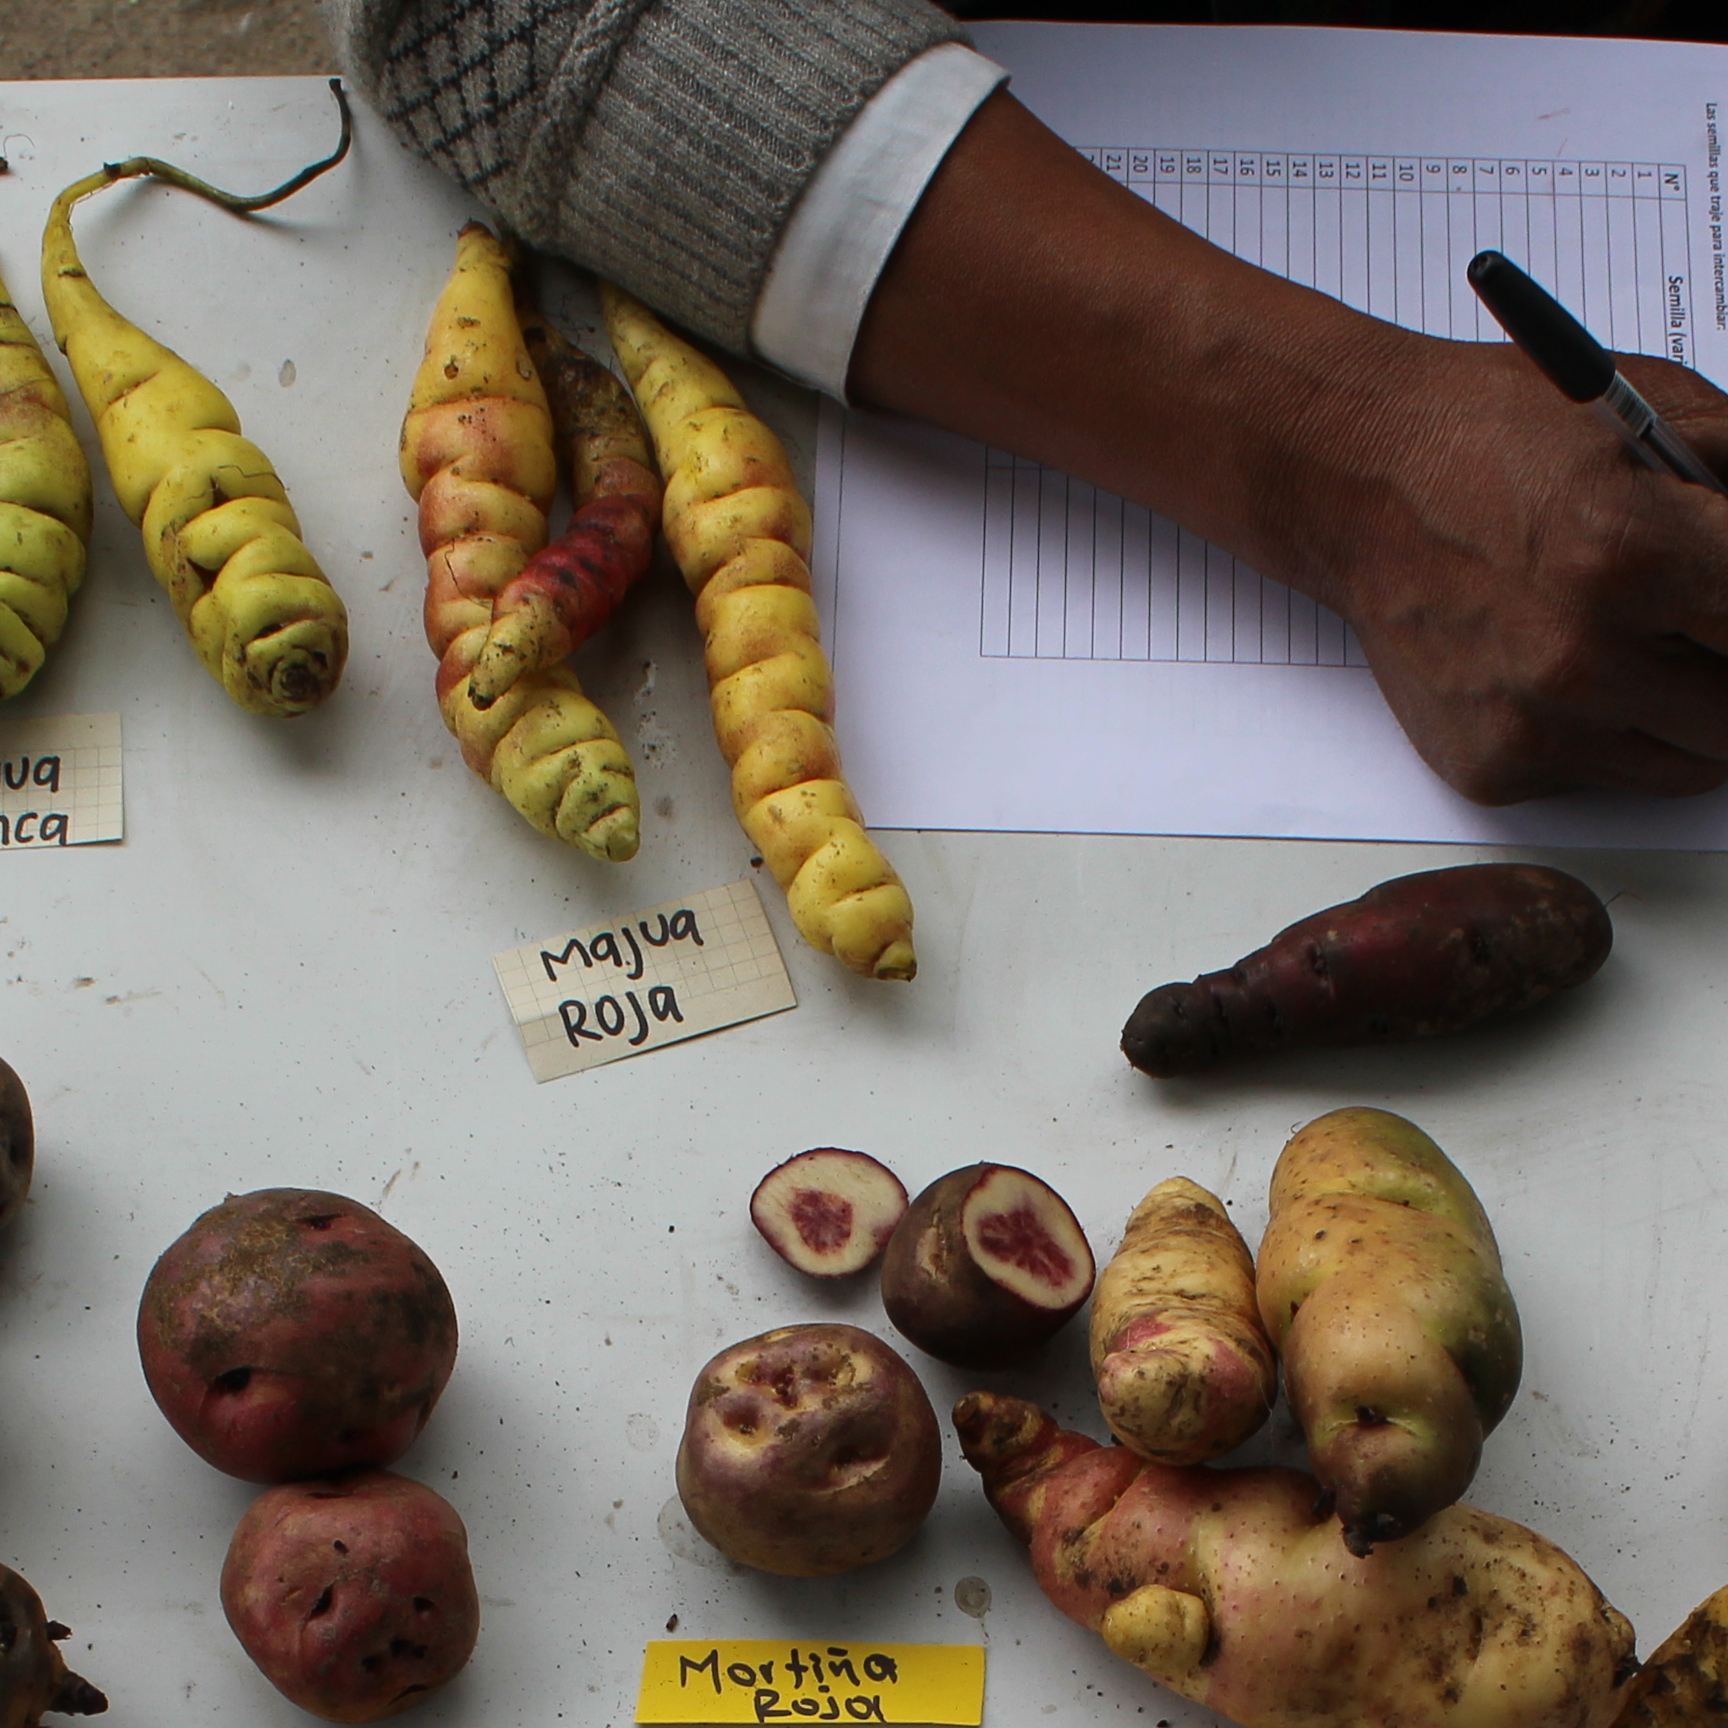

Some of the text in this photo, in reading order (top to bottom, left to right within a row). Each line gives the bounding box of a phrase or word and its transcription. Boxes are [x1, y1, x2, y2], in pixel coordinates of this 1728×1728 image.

[1706, 103, 1718, 120] Las
[1706, 122, 1720, 167] semillas
[1107, 155, 1121, 172] 21
[1134, 156, 1148, 172] 20
[1160, 157, 1174, 173] 19
[1187, 158, 1201, 174] 18
[1214, 158, 1227, 175] 17
[1240, 160, 1254, 176] 16
[1266, 160, 1280, 176] 15
[1293, 162, 1307, 178] 14
[1319, 162, 1333, 178] 13
[1346, 163, 1360, 178] 12
[1372, 163, 1387, 179] 11
[1427, 165, 1441, 173] 9
[1479, 166, 1492, 174] 7
[1506, 167, 1519, 175] 6
[1533, 167, 1546, 175] 5
[1559, 167, 1573, 176] 4
[1399, 165, 1413, 181] 10
[1585, 168, 1599, 177] 3
[1612, 169, 1625, 178] 2
[1638, 170, 1652, 178] 1
[1704, 170, 1720, 192] que
[1706, 194, 1724, 221] traje
[1708, 224, 1724, 251] para
[1668, 276, 1683, 327] Semilla
[539, 908, 704, 983] Majua
[680, 1647, 898, 1694] Mortiña
